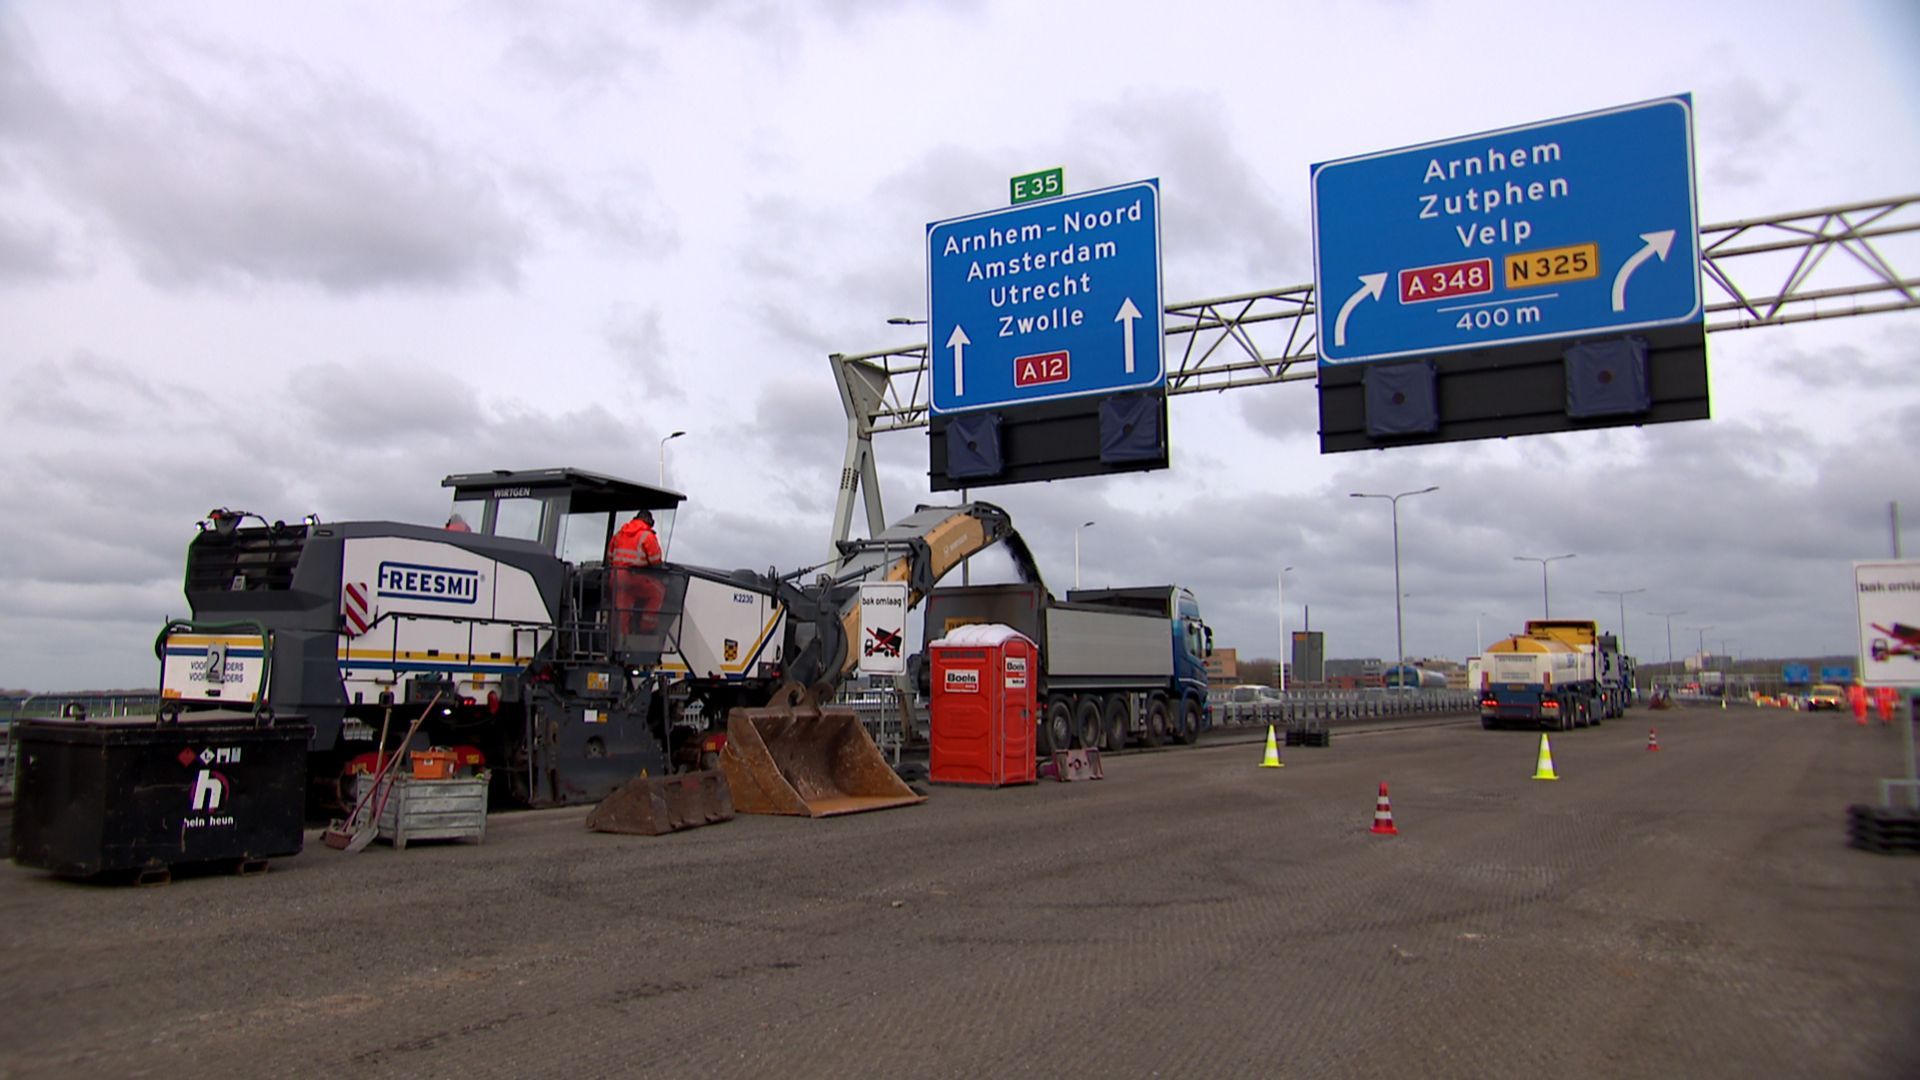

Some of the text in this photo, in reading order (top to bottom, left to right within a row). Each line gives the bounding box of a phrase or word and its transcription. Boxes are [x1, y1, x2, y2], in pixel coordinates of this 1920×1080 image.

[1423, 142, 1561, 183] Arnhem
[1014, 174, 1058, 199] E 35
[1418, 177, 1568, 219] Zutphen
[1456, 218, 1531, 247] Velp
[967, 240, 1116, 282] Amsterdam
[1512, 251, 1588, 281] N 325
[990, 272, 1091, 307] Utrecht
[1408, 267, 1483, 296] A 348
[998, 307, 1084, 337] Zwolle
[1456, 306, 1540, 330] 400 m
[1021, 358, 1064, 380] A12
[494, 487, 531, 498] WIRTGEN
[733, 592, 753, 604] K2230
[862, 597, 902, 608] bak omlaag
[209, 651, 220, 673] 2
[947, 672, 977, 682] Boels
[209, 815, 234, 826] heun
